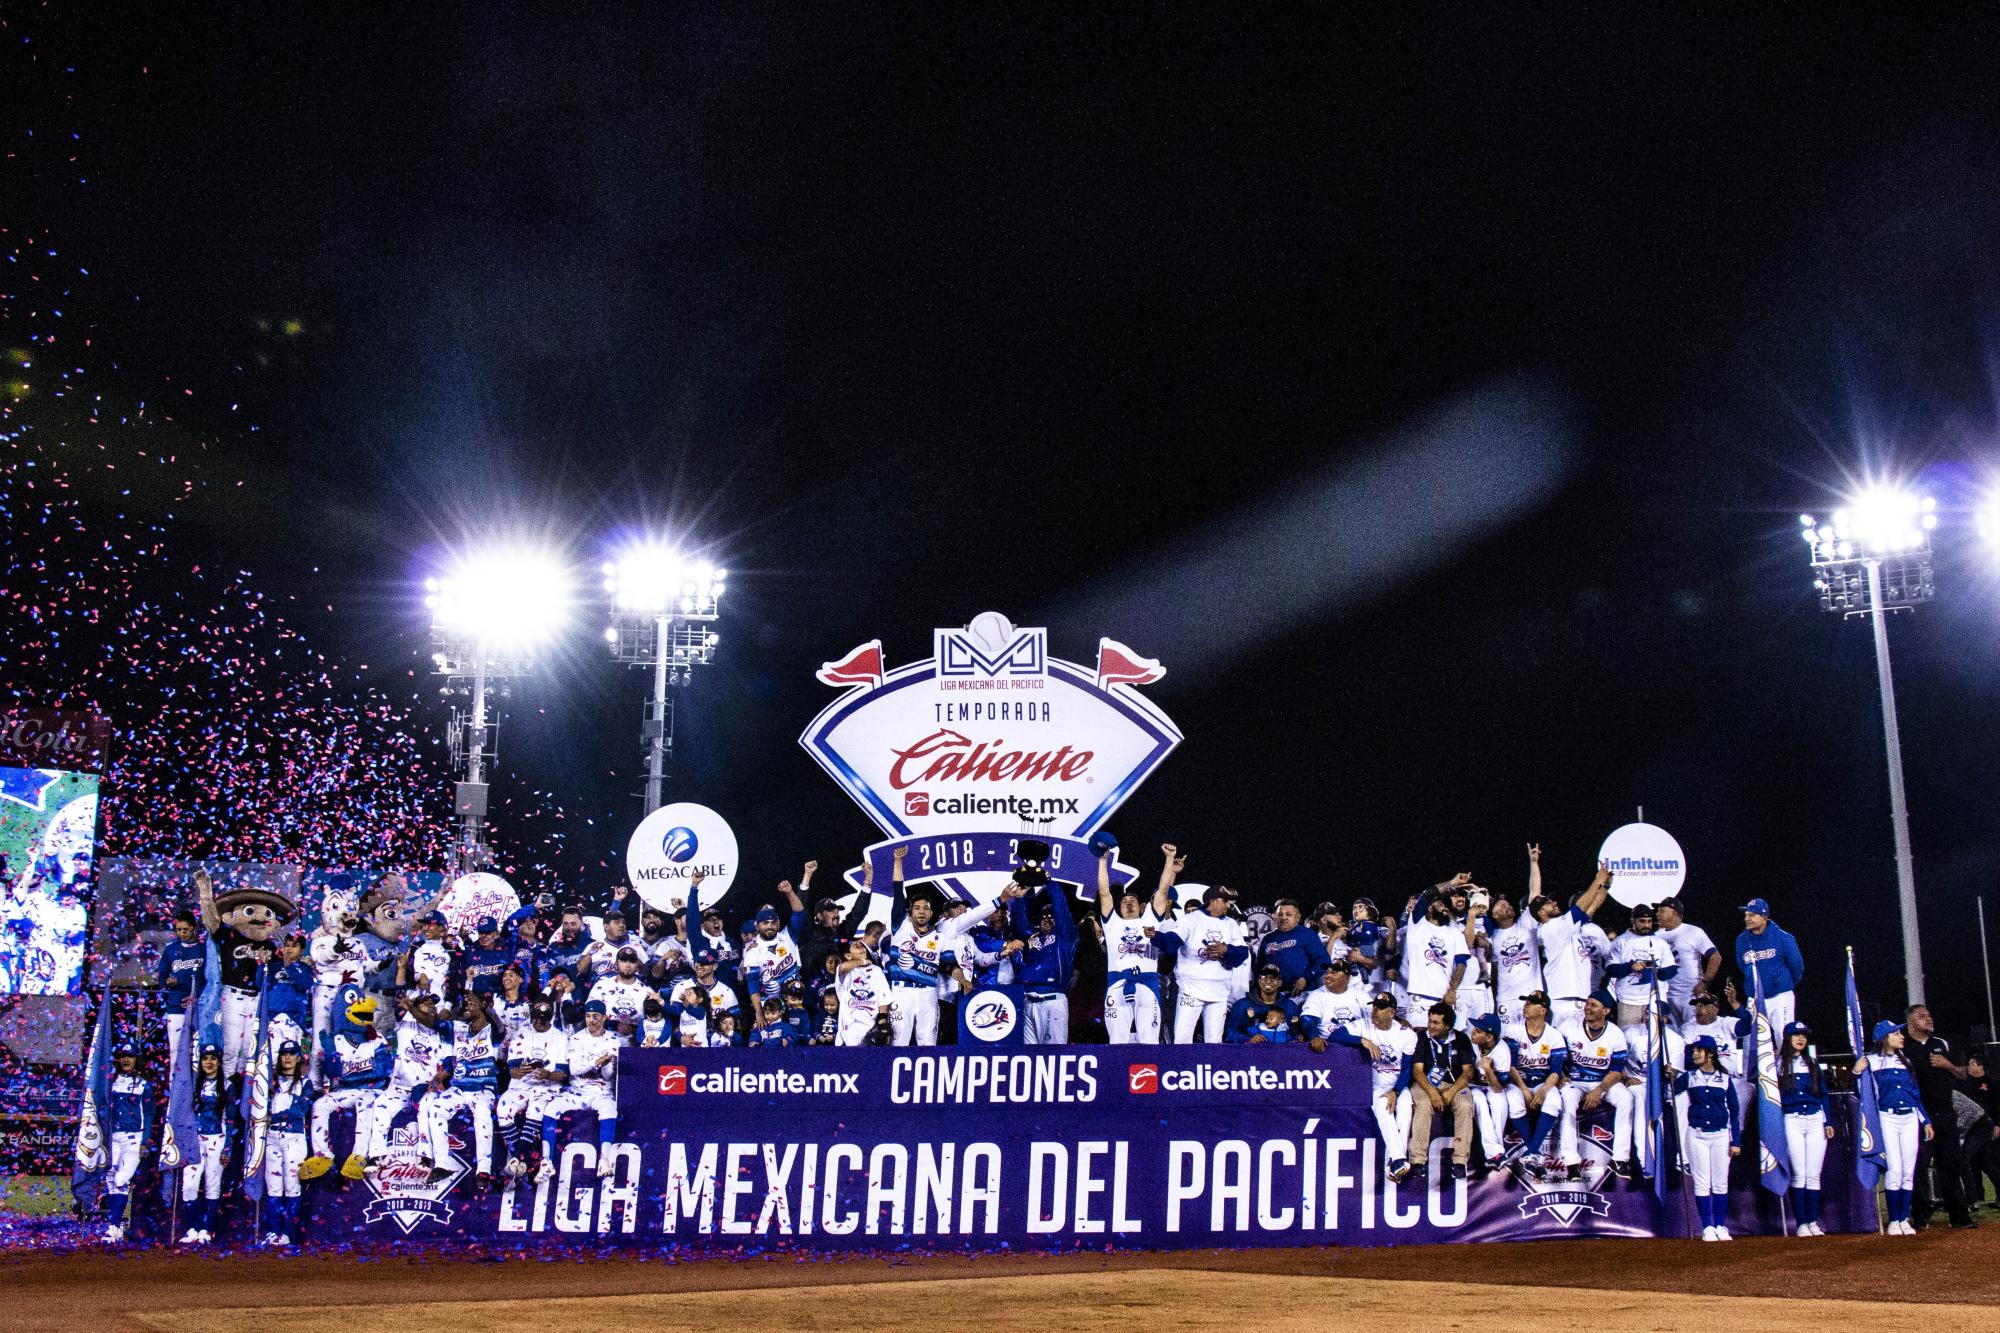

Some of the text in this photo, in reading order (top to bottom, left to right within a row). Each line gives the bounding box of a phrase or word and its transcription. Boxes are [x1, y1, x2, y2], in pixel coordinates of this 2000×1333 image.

[940, 677, 1044, 691] LIGA MEXICANA DEL PACÍFICO
[934, 701, 1050, 722] TEMPORADA
[888, 728, 1094, 790] Caliente
[932, 793, 1079, 815] caliente.mx
[919, 839, 974, 870] 2018
[1604, 857, 1679, 870] infinitum
[690, 1066, 860, 1094] caliente.mx
[890, 1054, 1098, 1104] CAMPEONES
[1161, 1063, 1332, 1090] caliente.mx
[662, 1142, 1002, 1235] MEXICANA
[1026, 1140, 1142, 1233] DEL
[1166, 1117, 1468, 1232] PACÍFICO
